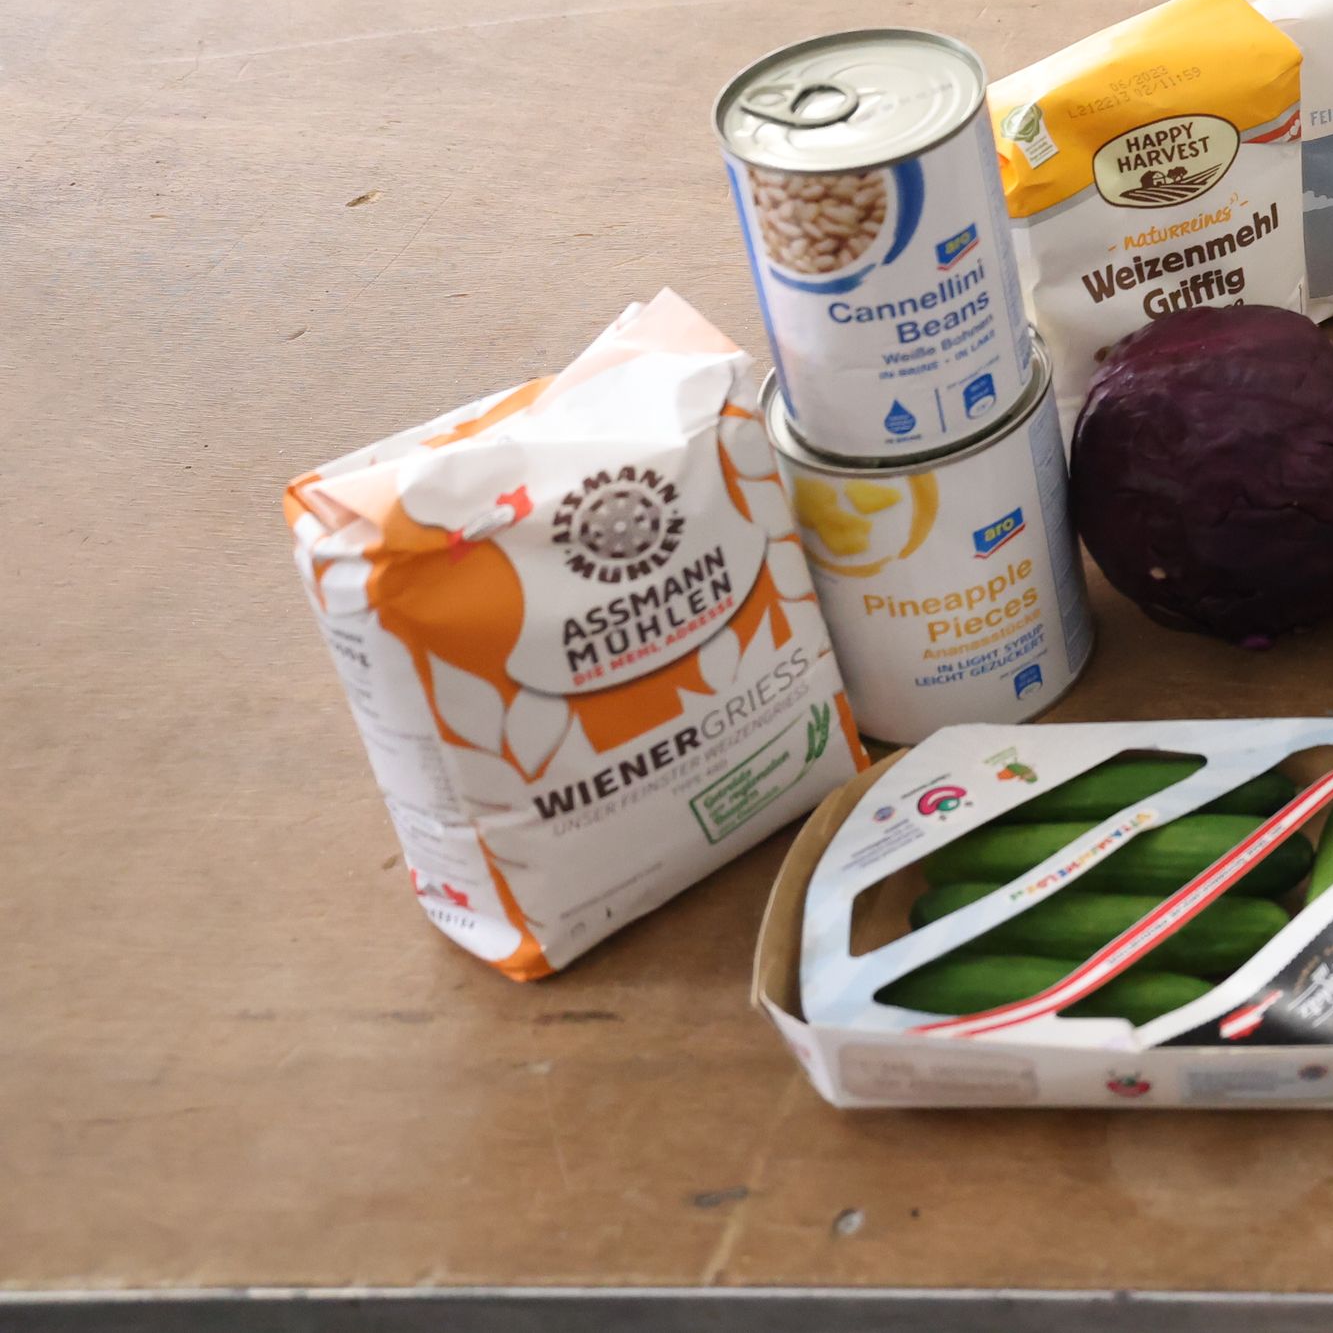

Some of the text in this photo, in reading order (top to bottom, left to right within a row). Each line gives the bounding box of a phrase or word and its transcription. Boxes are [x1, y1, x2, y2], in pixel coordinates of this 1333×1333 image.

[1110, 65, 1169, 92] 06/2023
[1117, 136, 1210, 173] HARVEST
[1126, 122, 1194, 153] HAPPY
[946, 230, 970, 254] aro
[1081, 202, 1279, 304] Weizenmehl
[828, 258, 985, 325] Cannellini
[896, 291, 990, 344] Beans
[1143, 267, 1246, 322] Griffig
[941, 314, 995, 352] Bohnen
[552, 465, 680, 544] ASSMANN
[984, 518, 1015, 542] aro
[563, 546, 727, 647] ASSMANN
[863, 558, 1033, 617] Pineapple
[927, 586, 1039, 644] Pieces
[566, 570, 733, 673] MÜHLEN
[572, 595, 735, 687] DIE MEHL ADRESSE
[958, 623, 1045, 669] LIGHT SYRUP
[914, 670, 965, 687] LEICHT
[970, 633, 1046, 678] GEZUCKERT
[533, 646, 809, 821] WIENERGRIESS
